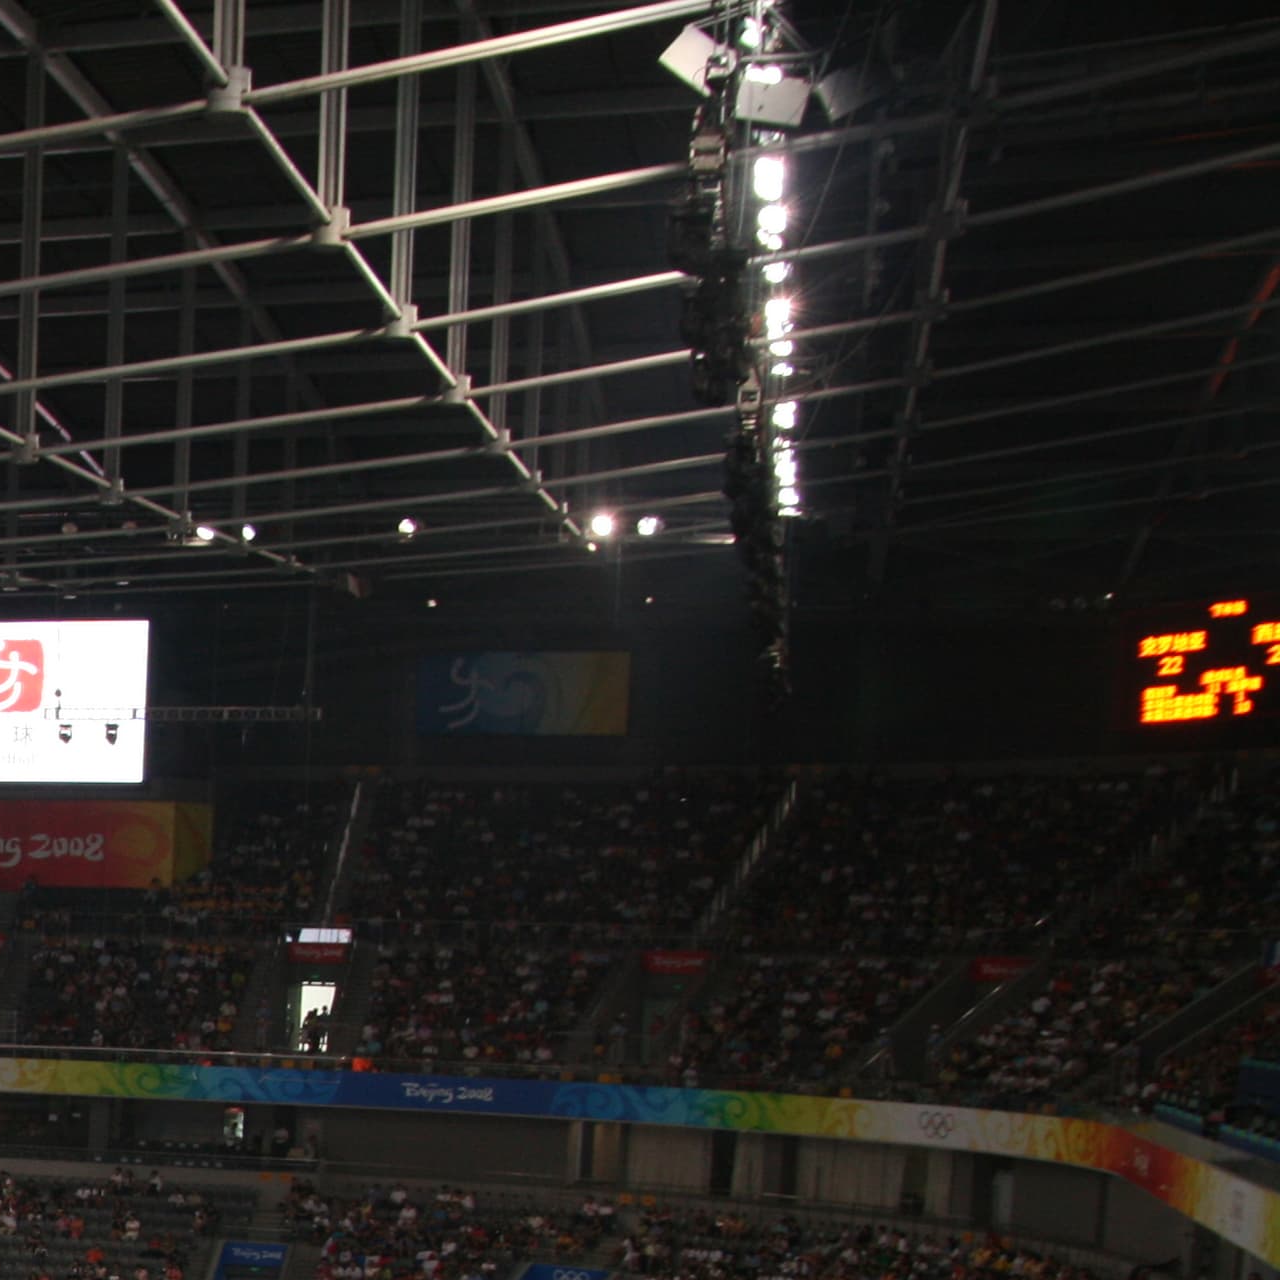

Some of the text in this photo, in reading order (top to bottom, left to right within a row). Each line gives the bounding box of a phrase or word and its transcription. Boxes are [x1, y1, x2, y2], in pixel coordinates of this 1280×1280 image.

[1157, 655, 1184, 677] 22
[29, 832, 105, 861] 2008
[401, 1082, 494, 1103] Beijing 2008
[231, 1246, 284, 1259] Beijing 2008
